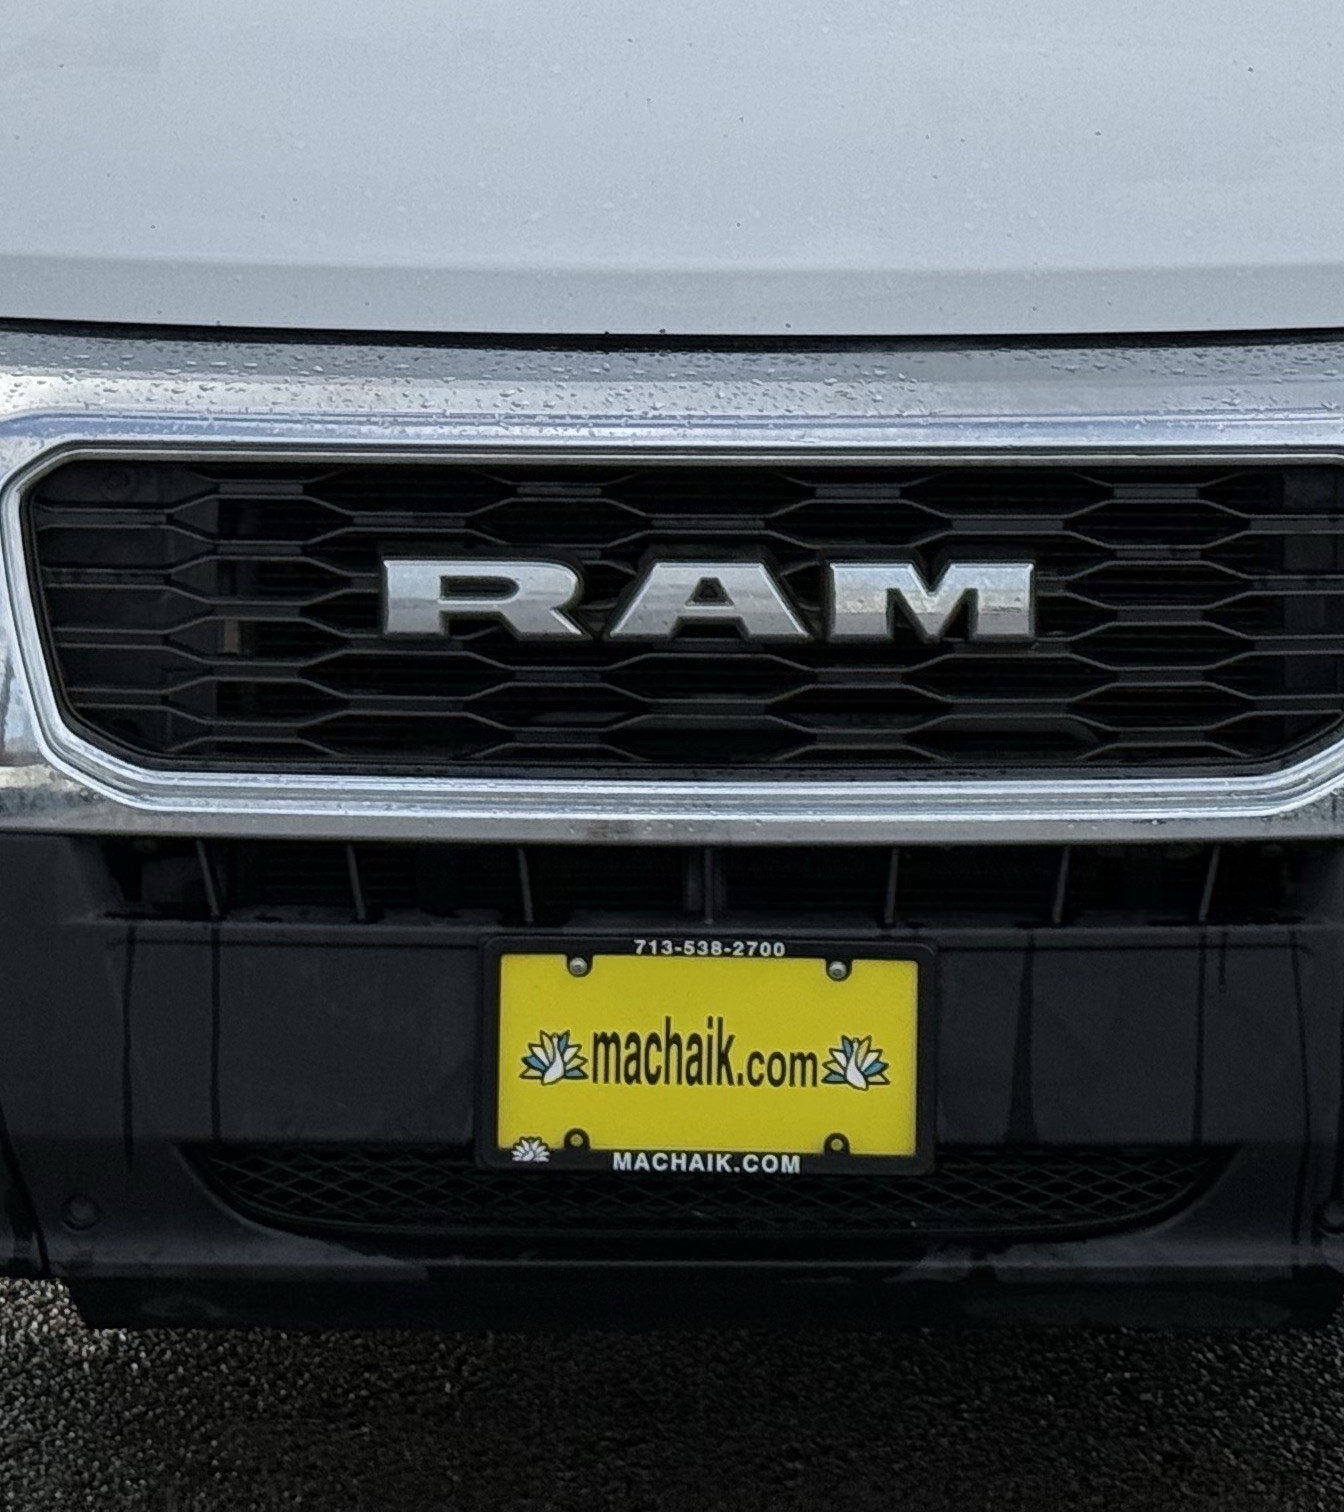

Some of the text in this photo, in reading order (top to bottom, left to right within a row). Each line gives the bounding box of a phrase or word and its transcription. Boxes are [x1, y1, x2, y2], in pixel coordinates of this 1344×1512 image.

[381, 559, 1036, 641] RAM
[634, 940, 786, 957] 713-538-2700
[592, 1016, 818, 1088] machaik.com
[612, 1152, 801, 1174] MACHAIK.COM
